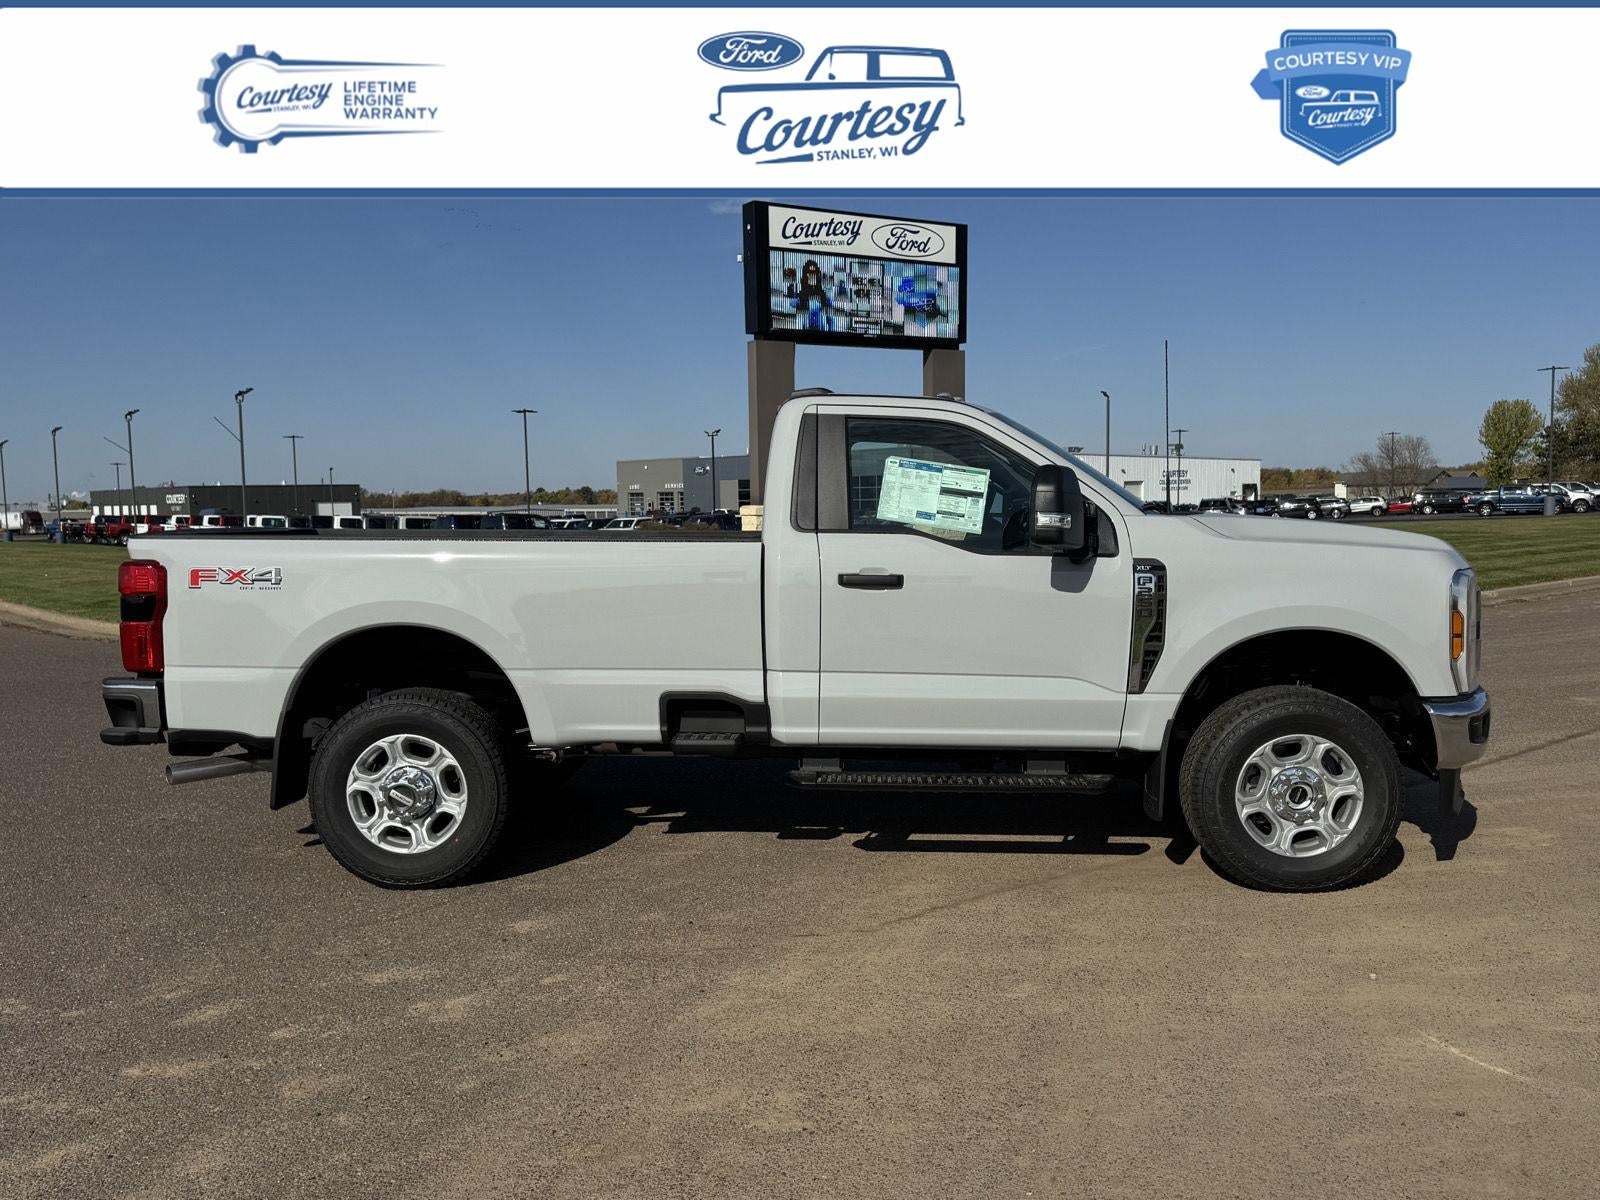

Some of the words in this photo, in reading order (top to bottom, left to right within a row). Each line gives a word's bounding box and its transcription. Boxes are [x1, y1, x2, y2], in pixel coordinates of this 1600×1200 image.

[781, 216, 863, 246] Courtesy
[885, 226, 932, 253] Ford
[188, 567, 282, 589] FX4
